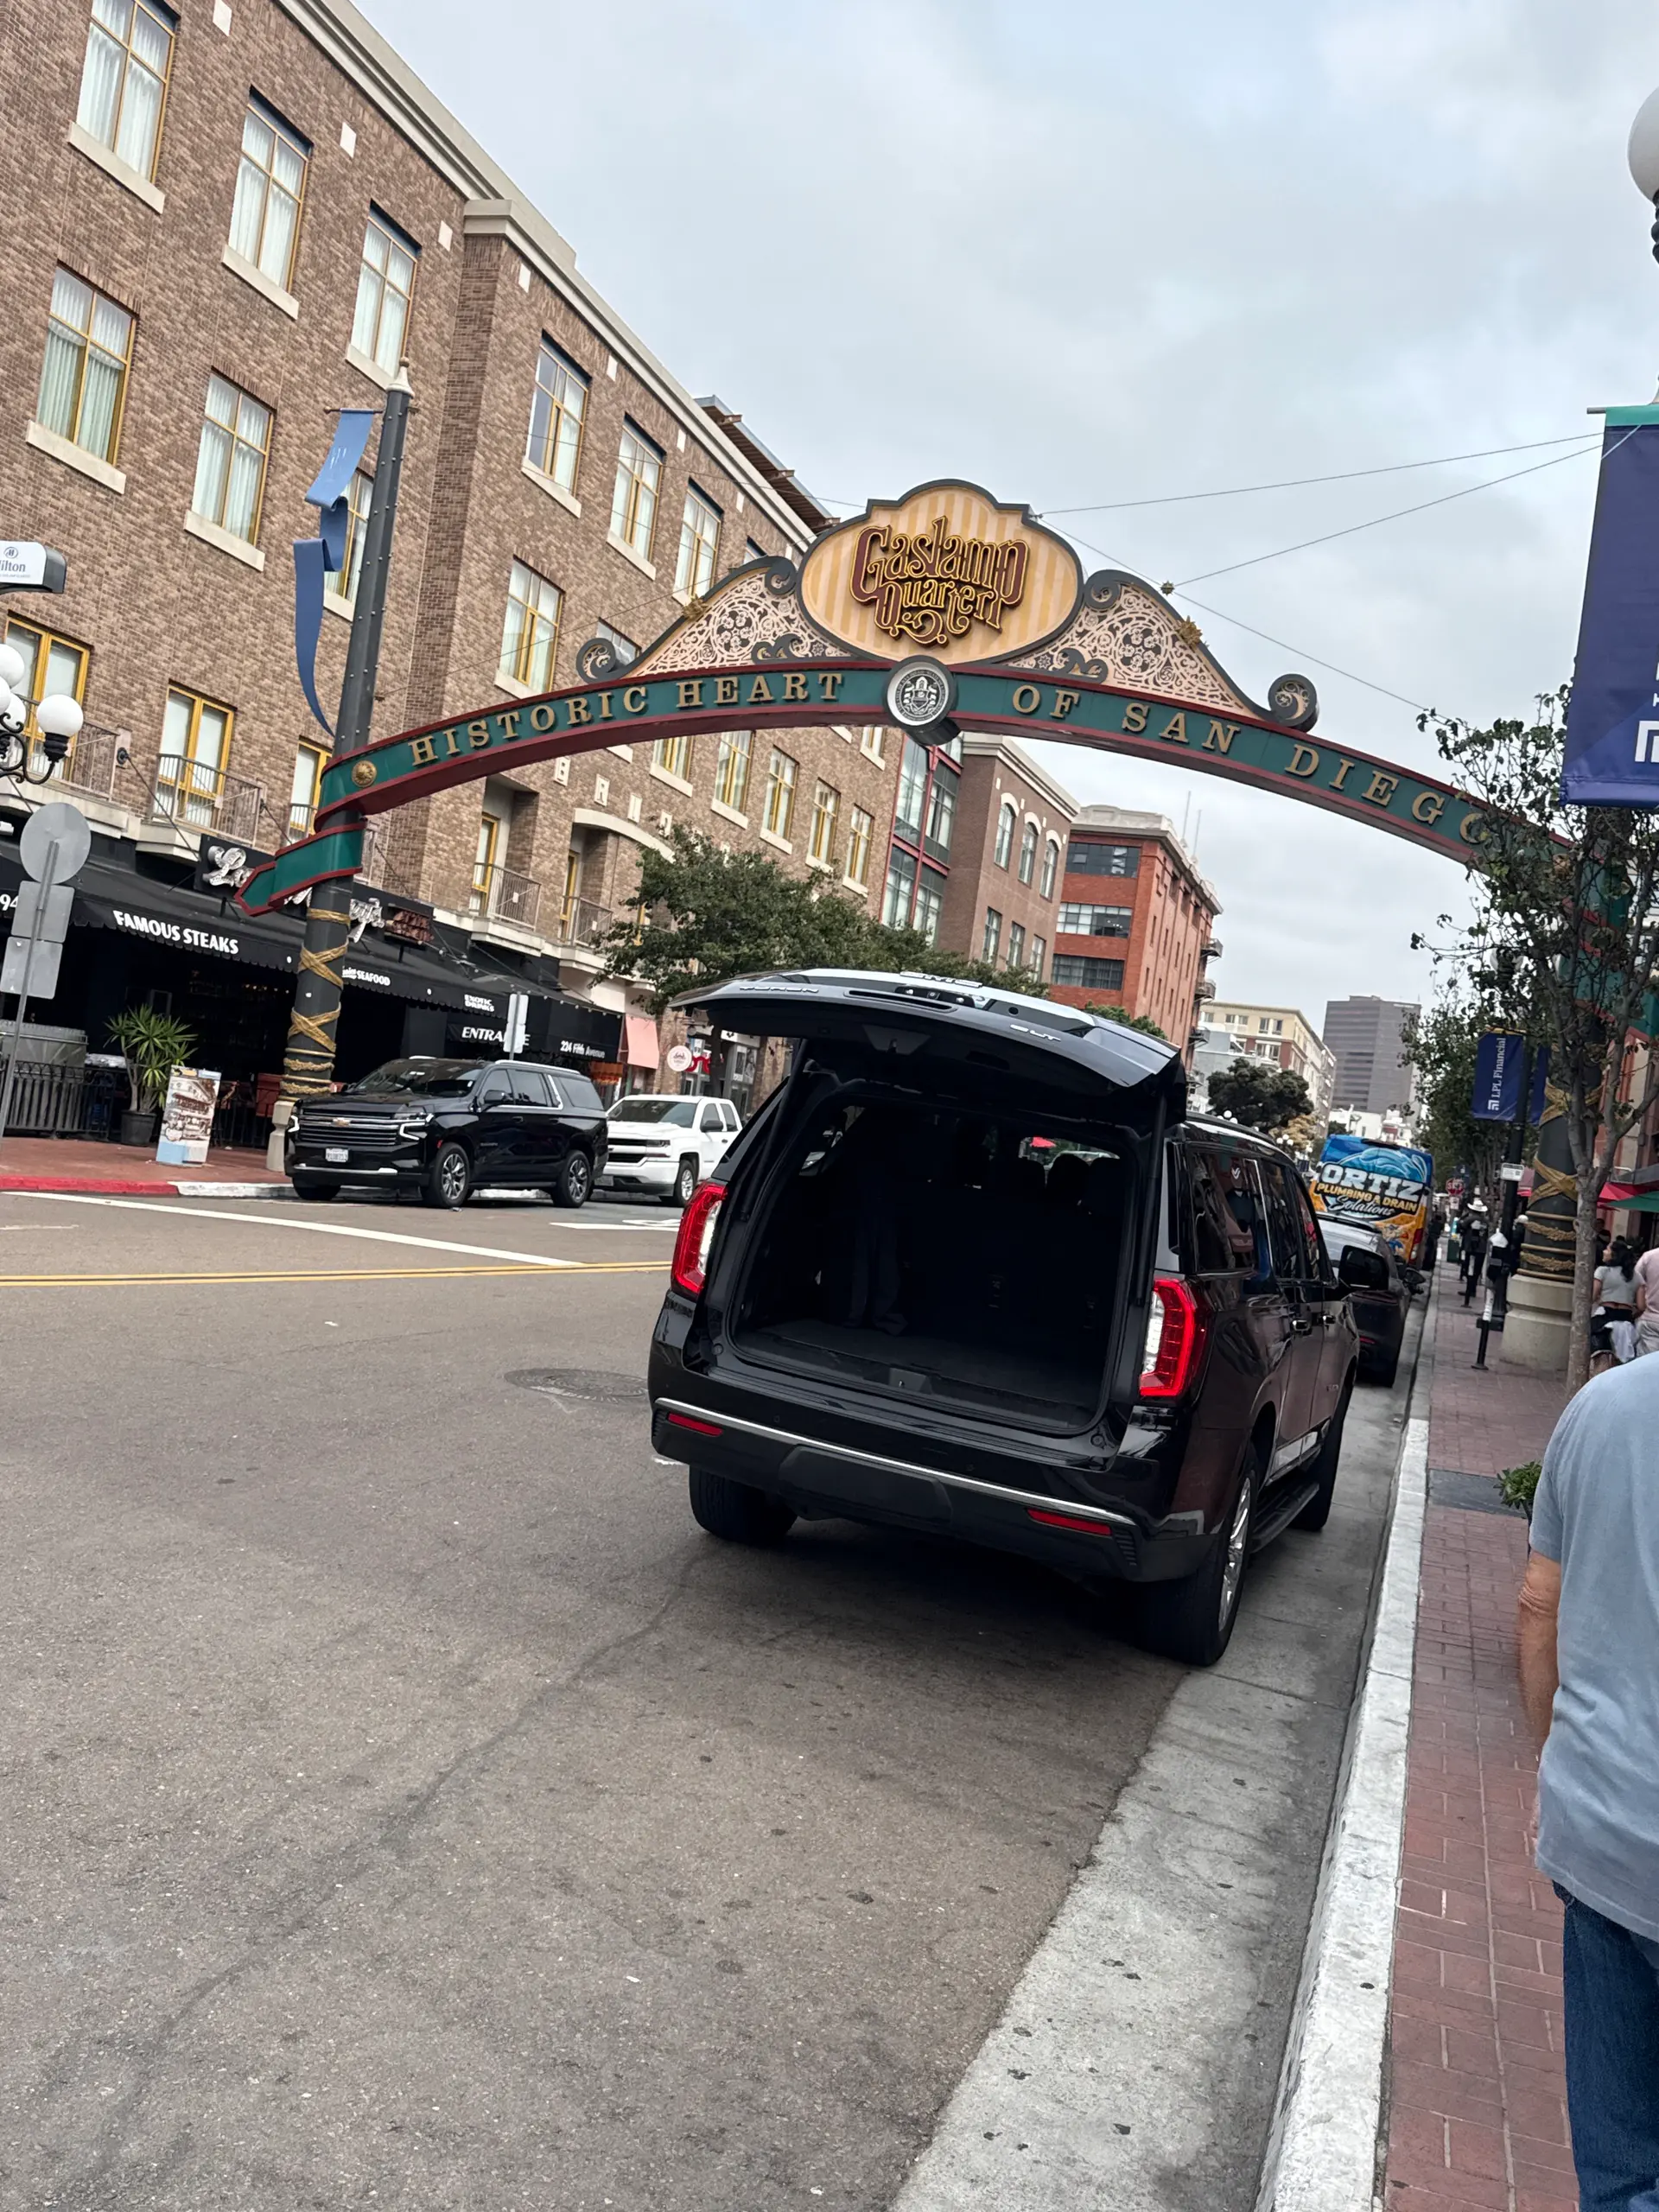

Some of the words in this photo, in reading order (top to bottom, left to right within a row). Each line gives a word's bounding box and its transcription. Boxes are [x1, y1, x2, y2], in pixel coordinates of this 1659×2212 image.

[0, 560, 26, 572] ilton
[850, 516, 1030, 632] Gaslamp
[874, 578, 1001, 645] Quarter
[408, 687, 648, 766] HISTORIC
[676, 672, 843, 709] HEART
[1012, 684, 1080, 719] OF
[1122, 702, 1241, 755] SAN
[112, 910, 181, 942] FAMOUS
[182, 928, 239, 955] STEAKS
[357, 969, 391, 986] SEAFOOD
[461, 1027, 531, 1046] ENTRAE
[560, 1040, 573, 1052] 224
[585, 1046, 606, 1058] Avenue
[1493, 1038, 1506, 1078] Financial
[1491, 1080, 1502, 1098] LPL
[1321, 1163, 1424, 1202] ORTIZ
[1317, 1183, 1373, 1202] PLUMBING
[1382, 1197, 1418, 1212] DRAIN
[1328, 1194, 1395, 1216] Solutions
